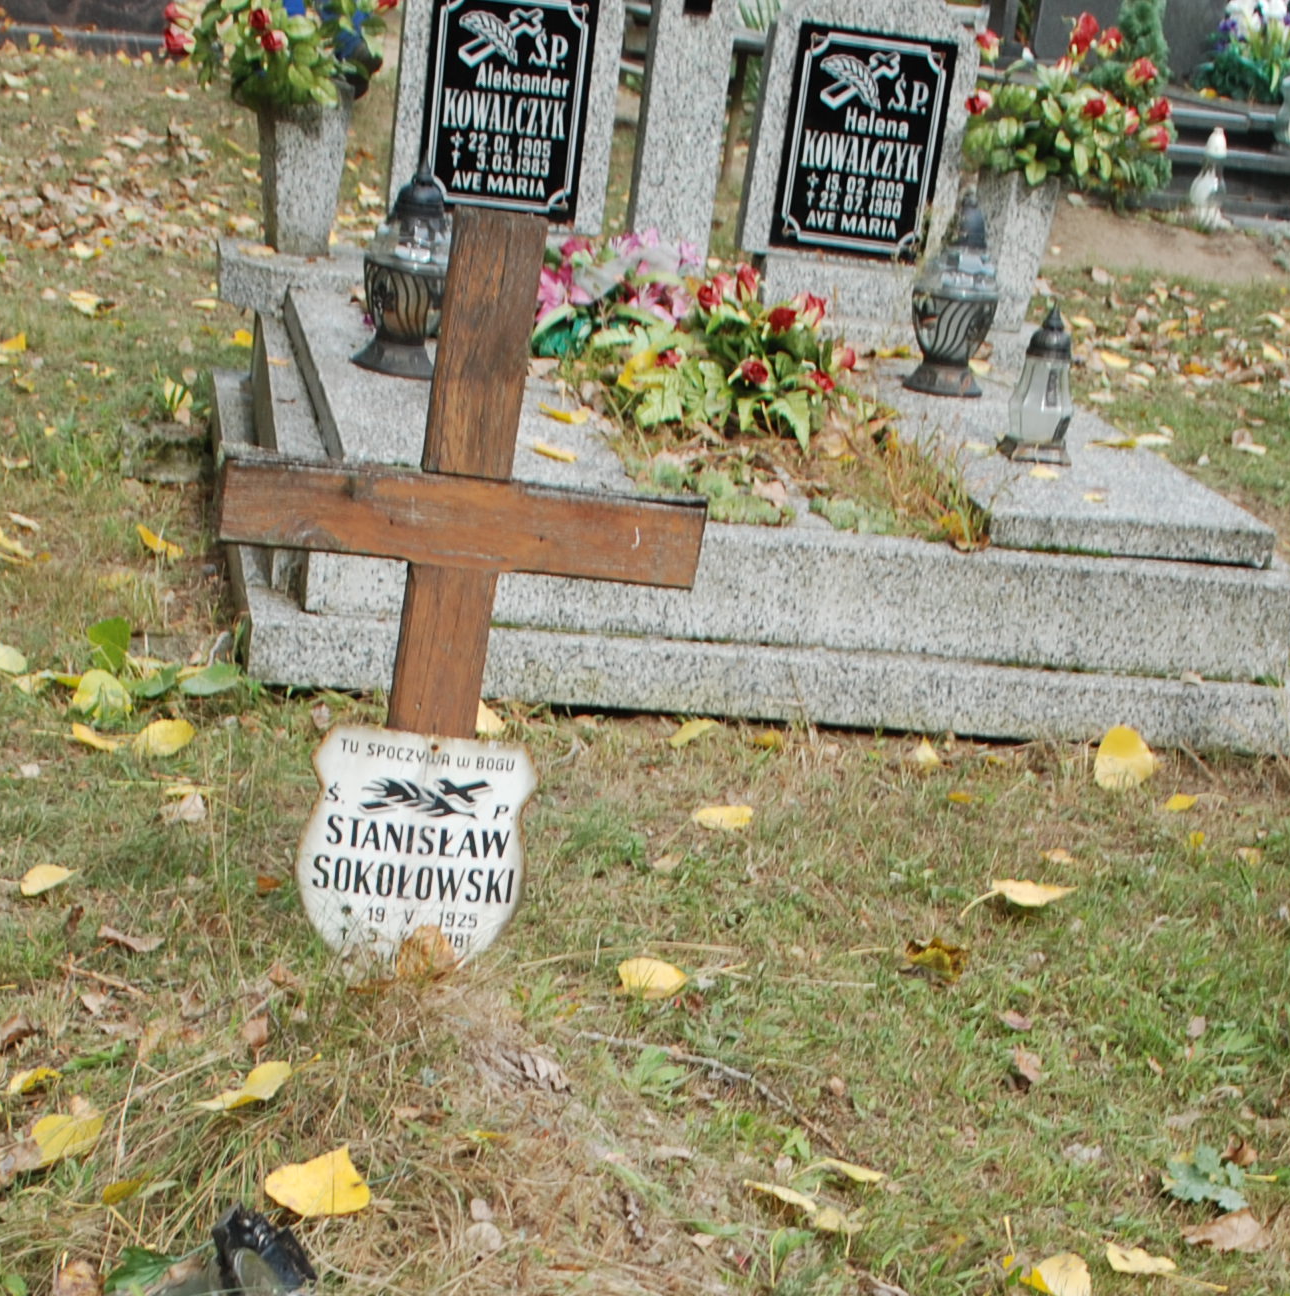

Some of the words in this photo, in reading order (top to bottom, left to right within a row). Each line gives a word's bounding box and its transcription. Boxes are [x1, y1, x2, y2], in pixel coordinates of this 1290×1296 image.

[475, 62, 570, 97] Aleksander
[442, 88, 566, 140] KOWALCZYK
[844, 106, 909, 139] Helena
[800, 129, 922, 183] KOWALCZYK
[451, 170, 482, 191] AVE
[487, 174, 545, 198] MARIA
[806, 210, 835, 231] AVE
[840, 214, 897, 238] MARIA
[340, 738, 359, 755] TU
[366, 742, 451, 767] SPOCZYWA
[475, 756, 515, 772] BOGU
[325, 814, 511, 859] STANISŁAW
[312, 854, 515, 904] SOKOŁOWSKI
[368, 906, 386, 923] 19
[440, 911, 478, 929] 1925
